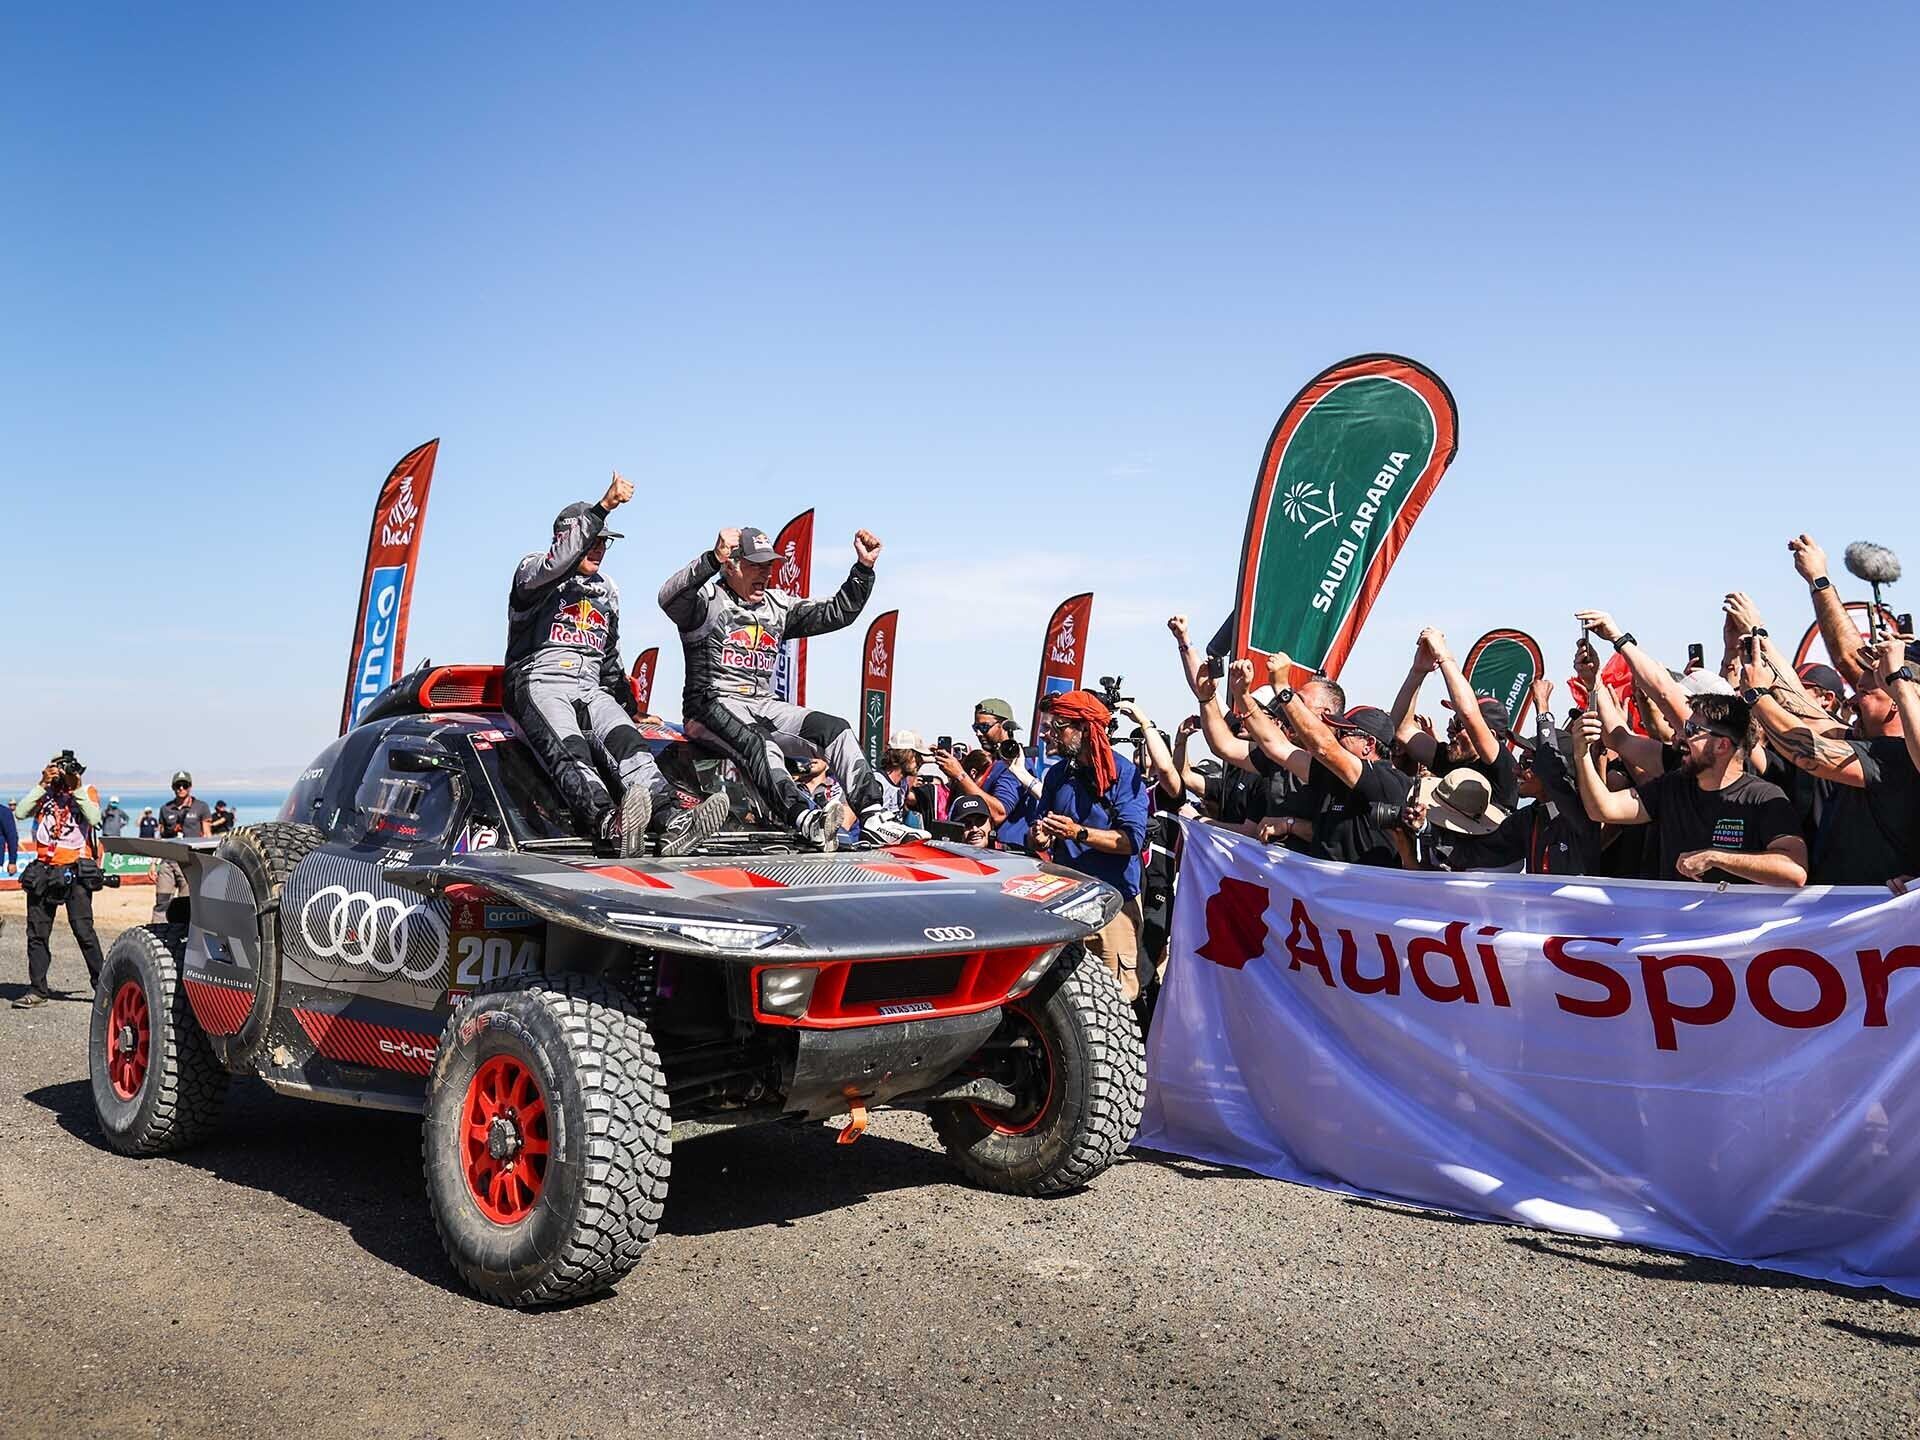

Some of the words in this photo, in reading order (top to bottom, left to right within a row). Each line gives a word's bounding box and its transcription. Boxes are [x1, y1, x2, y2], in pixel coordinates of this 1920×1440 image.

[1312, 539, 1359, 614] SAUDI
[1350, 450, 1411, 539] ARABIA
[549, 622, 583, 644] Red
[721, 648, 755, 669] Red
[456, 936, 541, 985] 204
[1285, 897, 1512, 1008] Audi
[1542, 936, 1920, 1051] Spor
